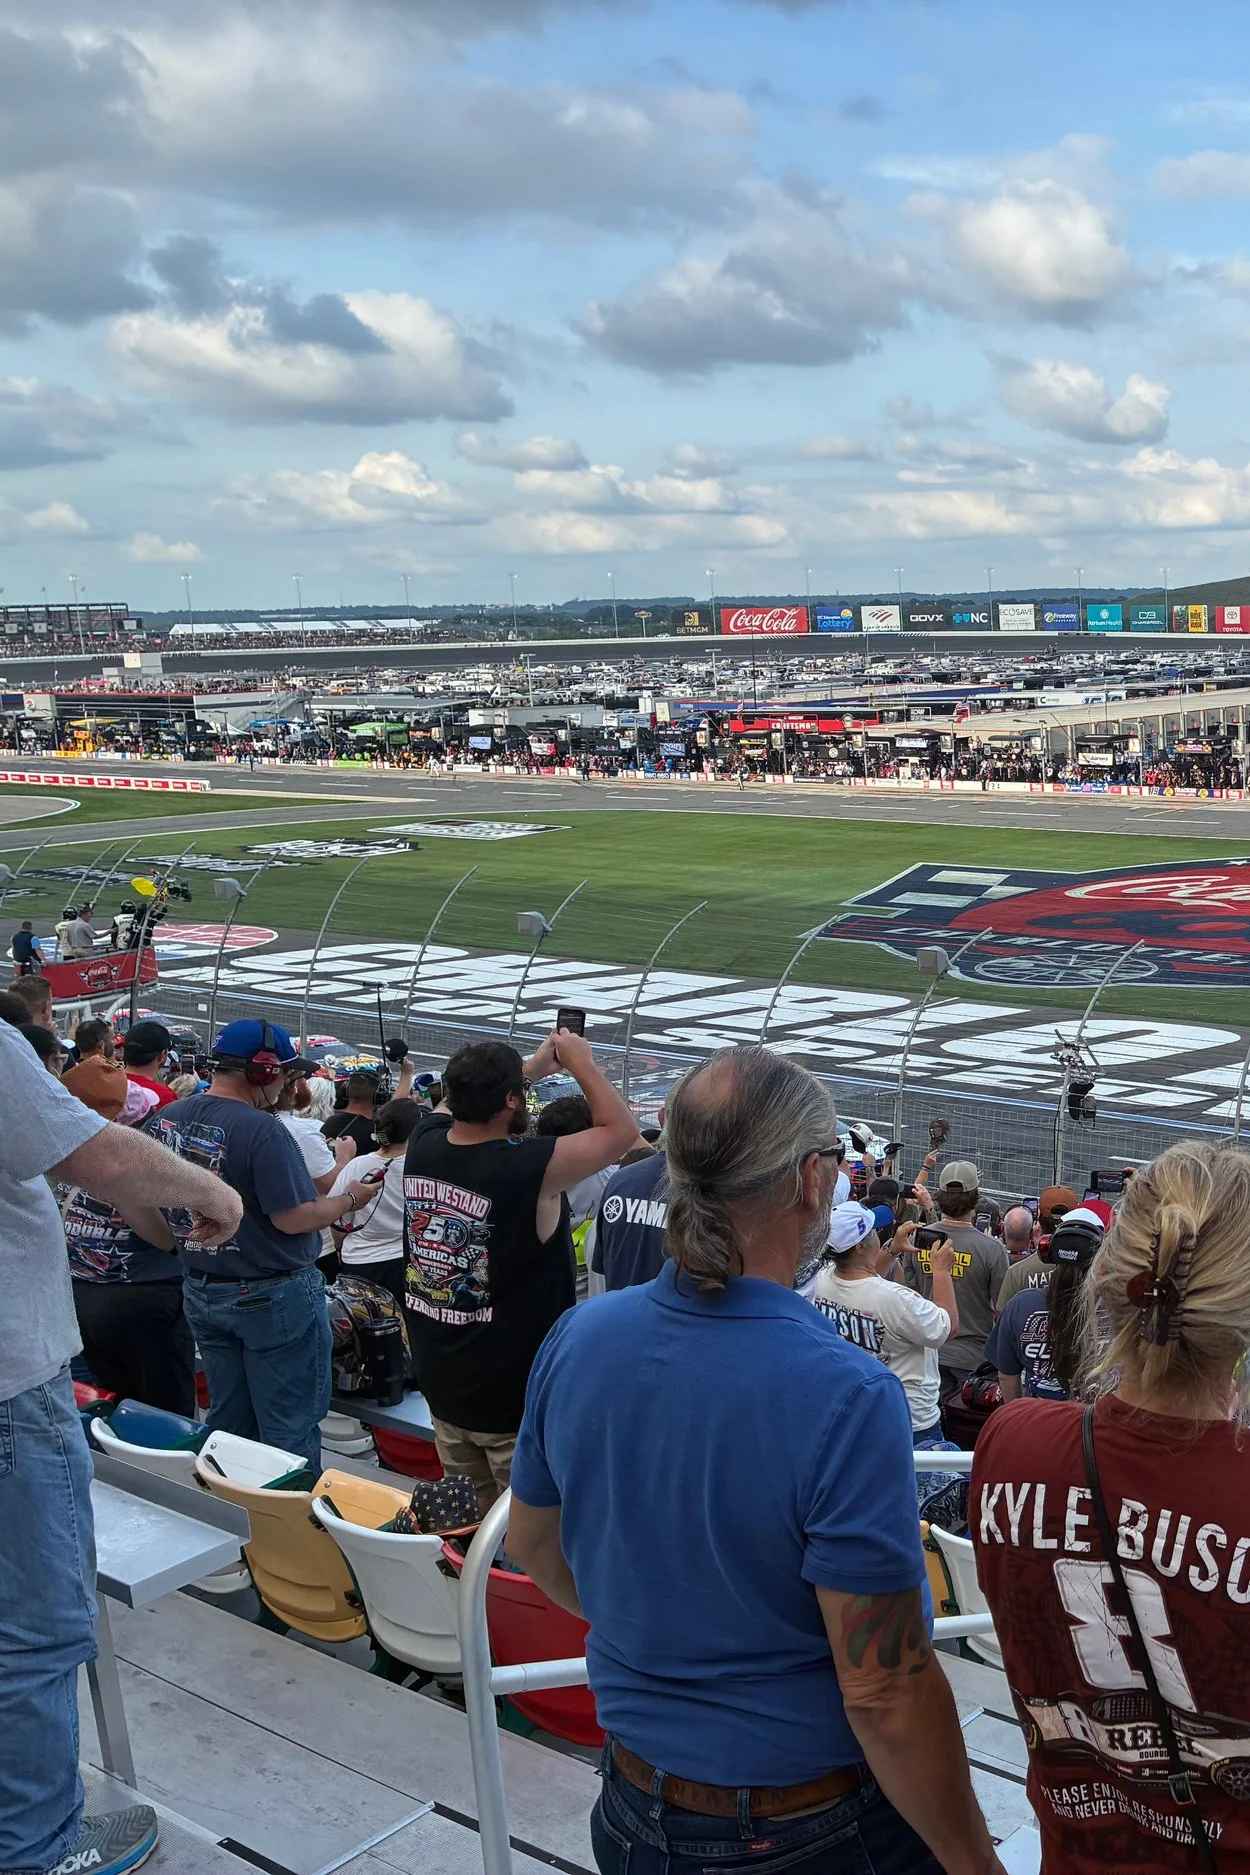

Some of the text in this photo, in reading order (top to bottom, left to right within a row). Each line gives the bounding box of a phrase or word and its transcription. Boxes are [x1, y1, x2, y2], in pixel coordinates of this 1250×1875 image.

[729, 608, 800, 632] Coca-Cola
[817, 619, 851, 630] Lottery
[909, 614, 944, 622] GOVX
[970, 612, 989, 623] NC
[1054, 612, 1077, 620] Freeway
[677, 626, 709, 634] BETMGM
[403, 1177, 435, 1200] UNITED
[625, 1197, 668, 1230] YAM
[441, 1307, 493, 1326] FREEDOM
[980, 1482, 1092, 1553] KYLE
[1041, 1784, 1089, 1805] PLEASE
[1093, 1783, 1129, 1805] ENJOY
[1051, 1803, 1073, 1819] AND
[1075, 1803, 1117, 1820] NEVER
[1151, 1822, 1174, 1840] AND
